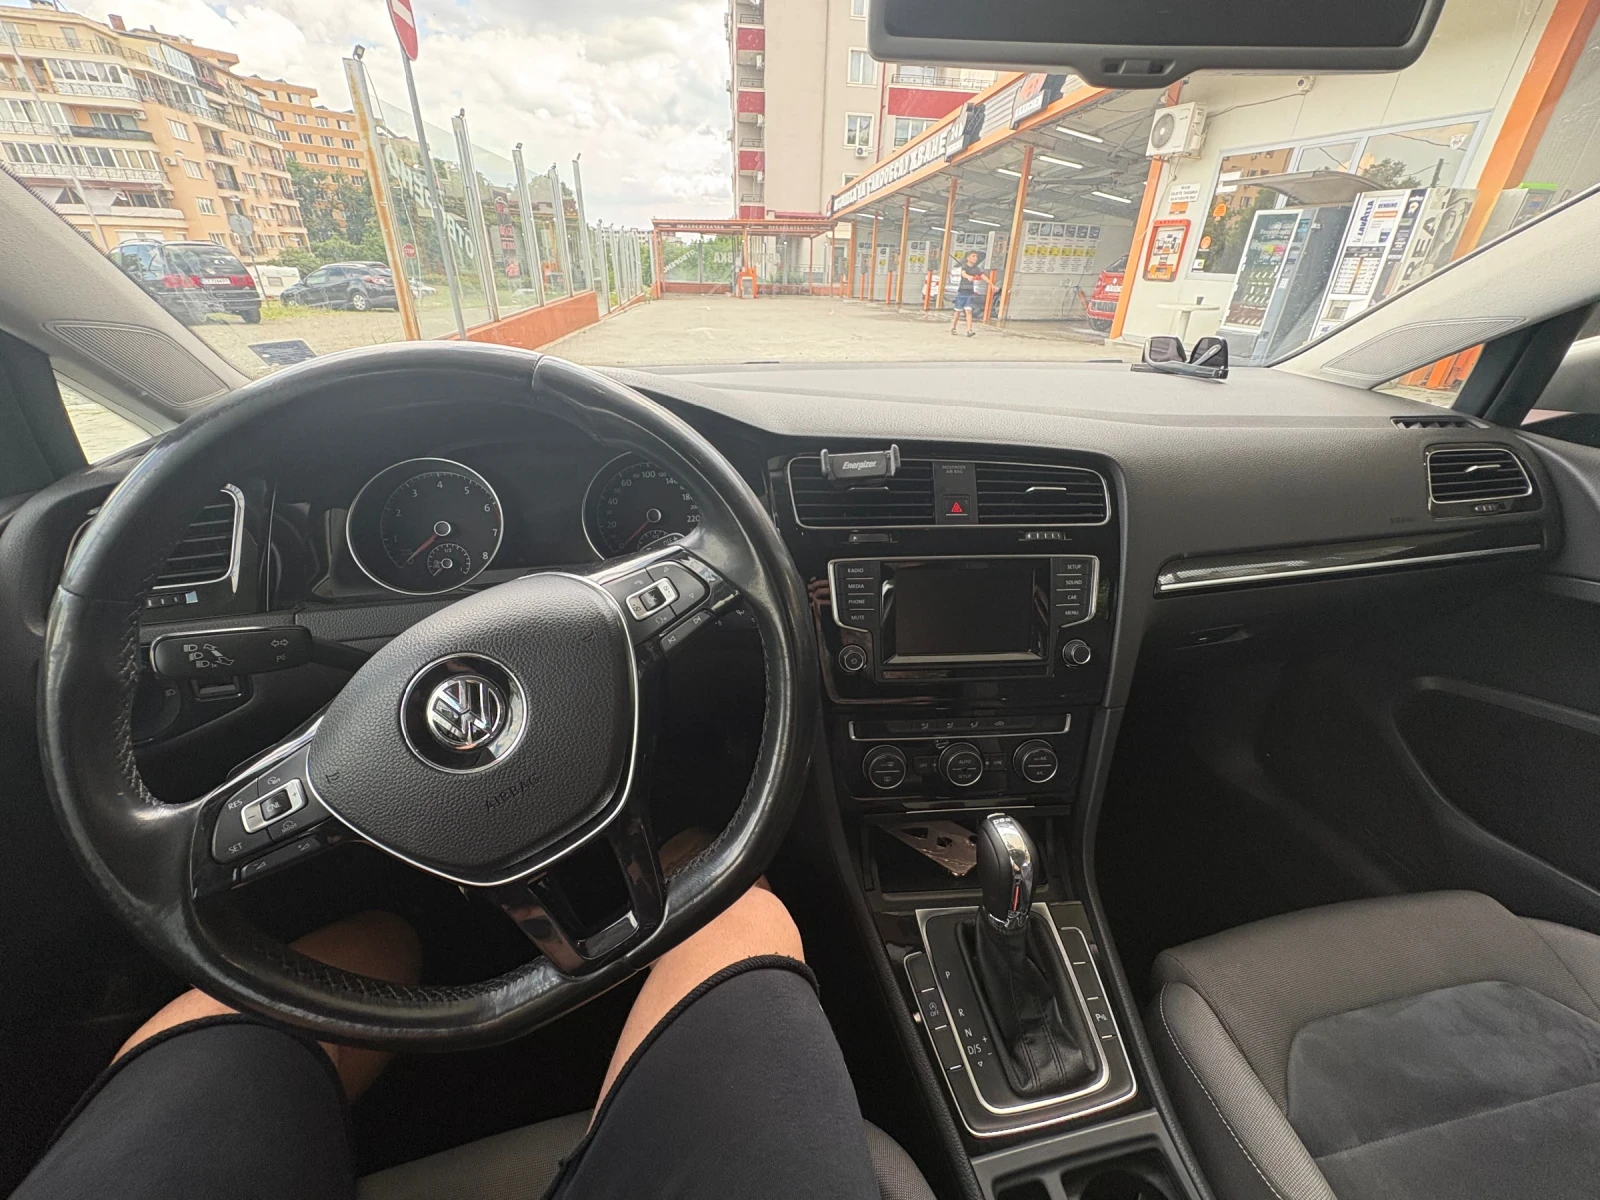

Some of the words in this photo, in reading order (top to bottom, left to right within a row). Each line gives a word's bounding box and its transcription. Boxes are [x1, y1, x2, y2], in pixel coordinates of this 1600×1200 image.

[1357, 200, 1375, 236] LAVAZZA
[842, 460, 877, 470] Energizer
[621, 479, 632, 487] 60
[412, 489, 418, 497] 3
[464, 486, 470, 494] 5
[682, 493, 693, 501] 18
[484, 503, 490, 512] 6
[396, 509, 402, 517] 2
[492, 529, 498, 537] 7
[482, 552, 489, 560] 8
[485, 773, 541, 812] AIRBAG
[227, 799, 243, 811] RES
[266, 802, 281, 812] CNL
[281, 823, 298, 833] MODE
[229, 842, 243, 854] SET
[945, 970, 951, 979] P
[958, 1008, 965, 1017] R
[965, 1028, 973, 1037] N
[967, 1043, 982, 1055] D/S
